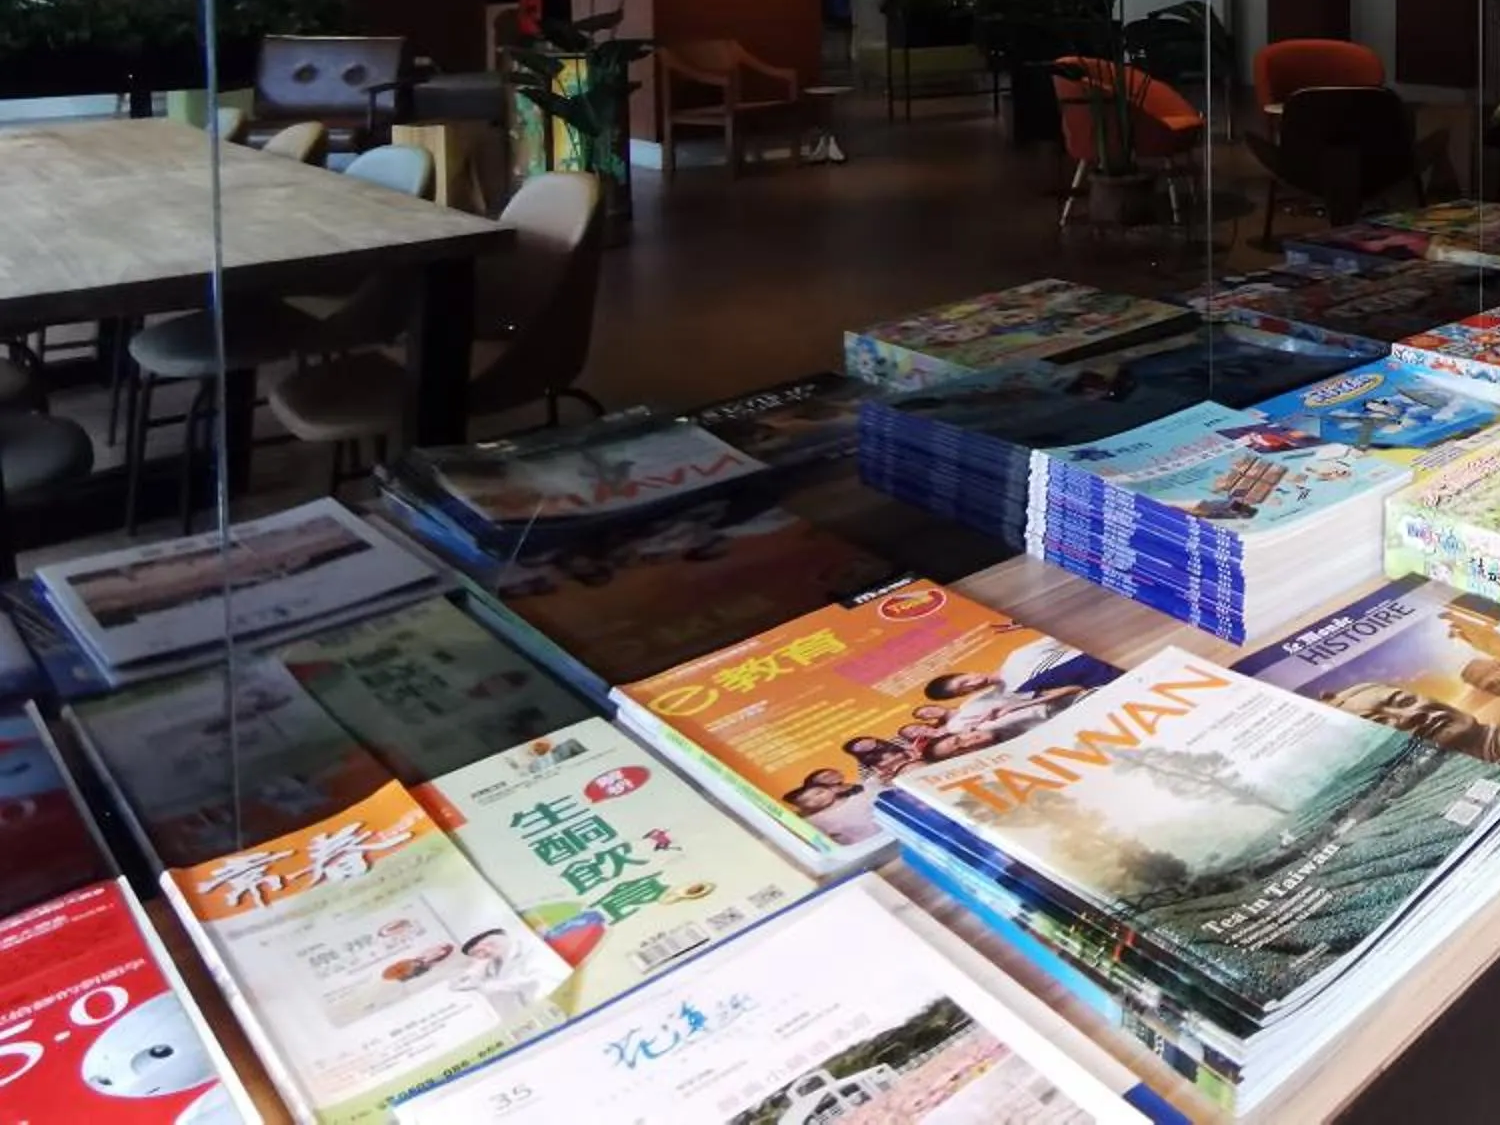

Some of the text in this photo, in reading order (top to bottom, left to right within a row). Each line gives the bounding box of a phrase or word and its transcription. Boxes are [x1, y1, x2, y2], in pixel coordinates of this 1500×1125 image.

[1296, 602, 1416, 666] HISTOIRE
[939, 664, 1232, 815] TAIWAN
[510, 795, 669, 925] 生酮飲食
[1200, 843, 1341, 934] Tea in Taiwan
